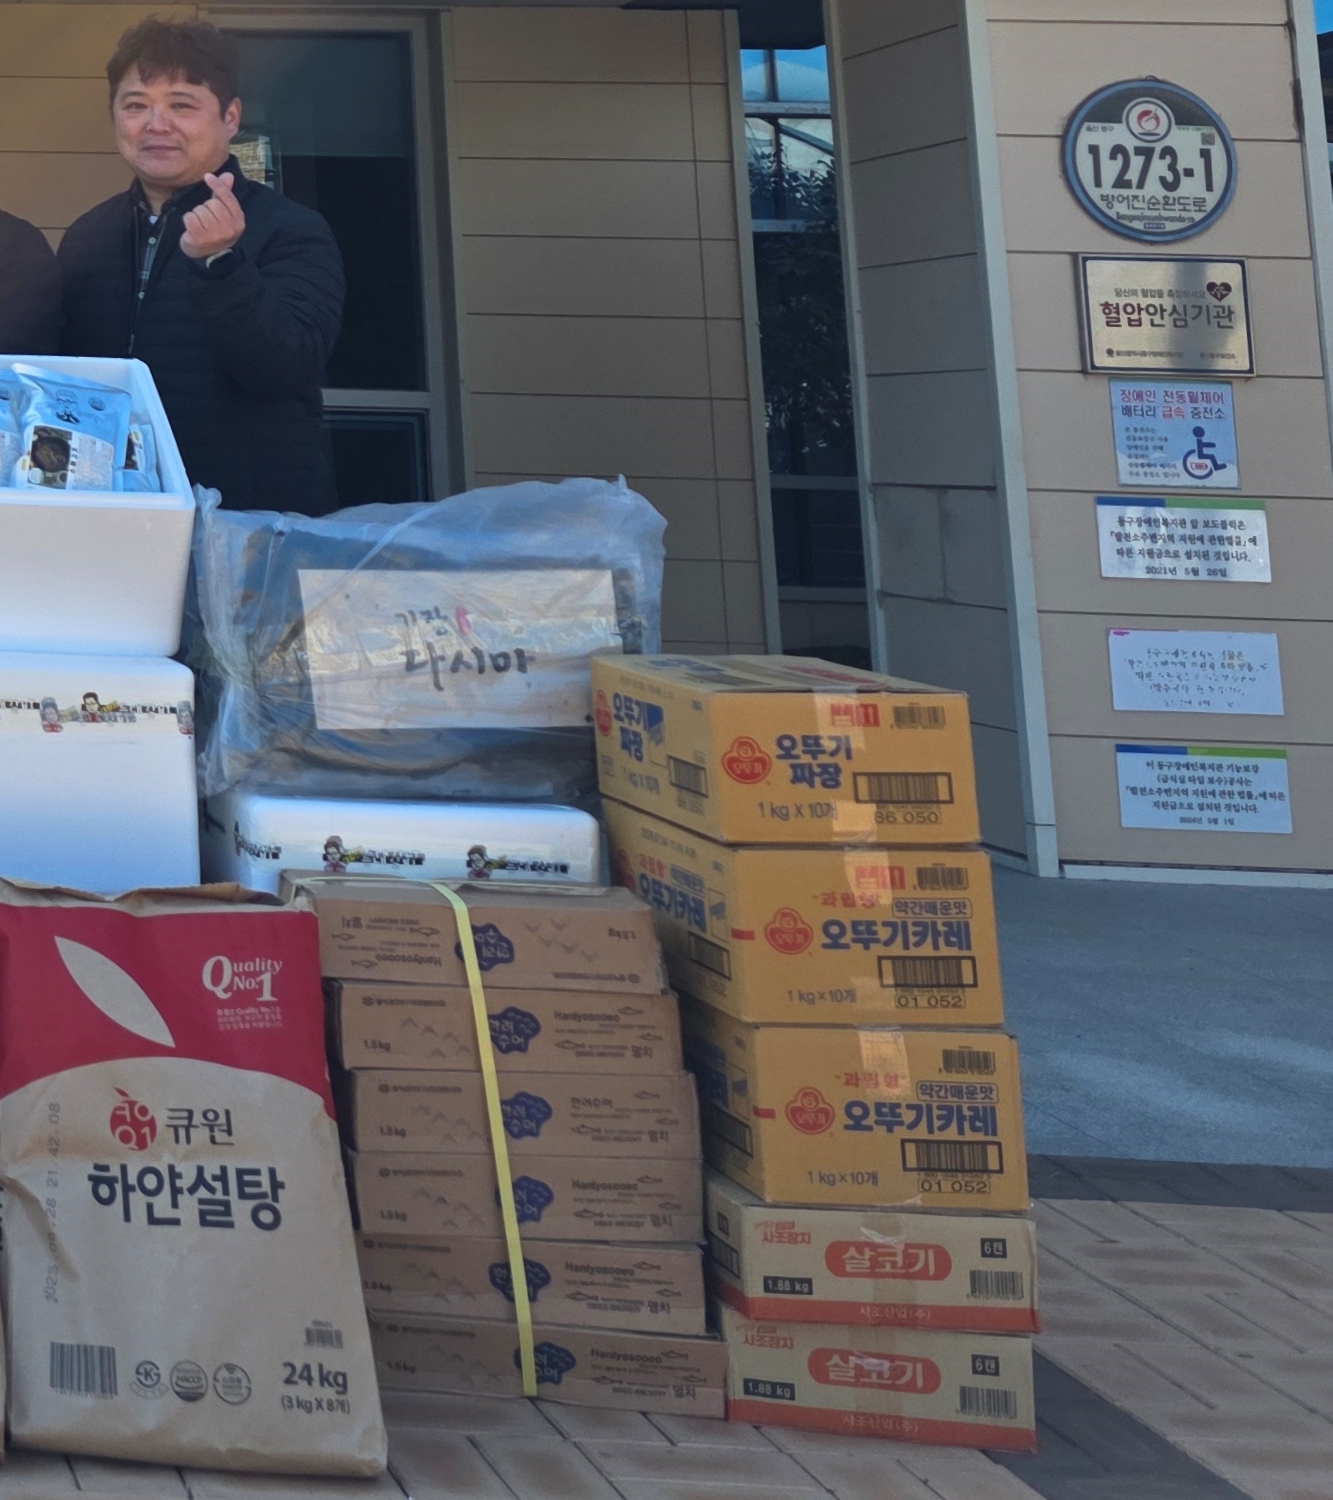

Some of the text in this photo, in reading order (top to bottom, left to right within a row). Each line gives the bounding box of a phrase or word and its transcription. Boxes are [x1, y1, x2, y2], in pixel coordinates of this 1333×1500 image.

[1088, 144, 1214, 192] 1273-1
[1100, 193, 1207, 213] 방어진순환도로
[1114, 288, 1138, 298] 당신의
[1141, 288, 1164, 298] 혈압을
[1099, 301, 1235, 329] 혈압안심기관
[1120, 389, 1224, 404] 장애인 전동휠체어
[1122, 405, 1225, 419] 배터리 급속 충전소
[1117, 516, 1187, 528] 동구장애인복지관
[1179, 534, 1204, 545] 지원에
[1116, 548, 1133, 558] 따른
[1138, 548, 1180, 559] 지원금으로
[1184, 549, 1210, 560] 설치된
[1146, 566, 1227, 578] 2021년 5월 26일
[401, 642, 536, 691] 다시마
[775, 734, 852, 761] 오뚜기
[1146, 761, 1154, 770] 이
[1157, 761, 1224, 772] 동구장애인복지관
[789, 763, 842, 789] 짜장
[770, 802, 790, 820] kg
[894, 899, 968, 916] 약간매운맛
[821, 919, 972, 951] 오뚜기카레
[202, 955, 283, 998] Quality
[897, 996, 963, 1008] 01 052
[631, 1045, 653, 1058] 멸치
[919, 1082, 994, 1100] 약간매운맛
[165, 1108, 234, 1146] 큐원
[920, 1181, 988, 1194] 01 052
[87, 1162, 285, 1232] 하얀설탕
[761, 1230, 811, 1245] 사조참치
[983, 1241, 1004, 1256] 6캔
[841, 1247, 936, 1276] 살코기
[766, 1280, 809, 1294] 1.88 kg
[826, 1356, 924, 1389] 살코기
[975, 1358, 996, 1373] 6캔
[283, 1361, 315, 1387] 24
[747, 1382, 773, 1395] 1.88
